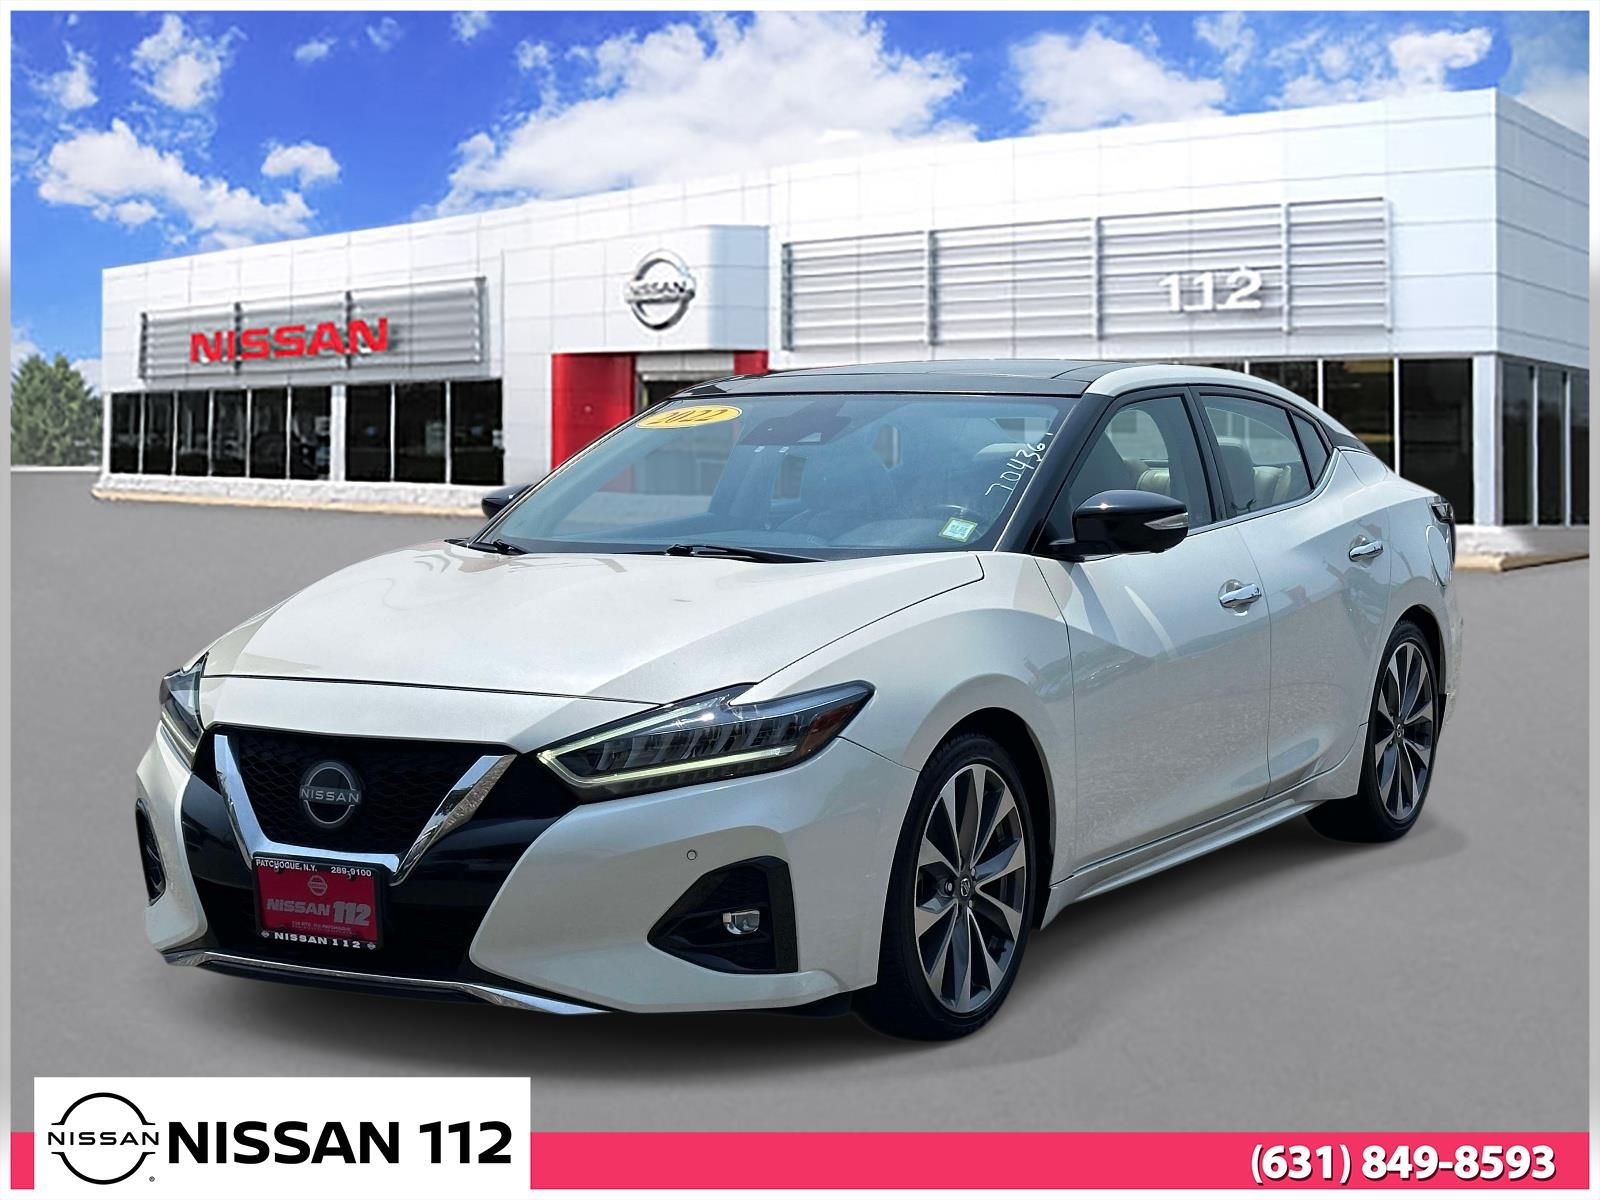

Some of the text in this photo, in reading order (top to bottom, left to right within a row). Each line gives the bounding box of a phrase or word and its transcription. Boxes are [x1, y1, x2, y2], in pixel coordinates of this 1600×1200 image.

[1158, 268, 1262, 312] 112
[190, 317, 388, 363] NISSAN
[301, 788, 359, 802] NISSAN
[267, 898, 331, 916] NISSAN
[333, 901, 371, 927] 112
[274, 931, 328, 945] NISSAN
